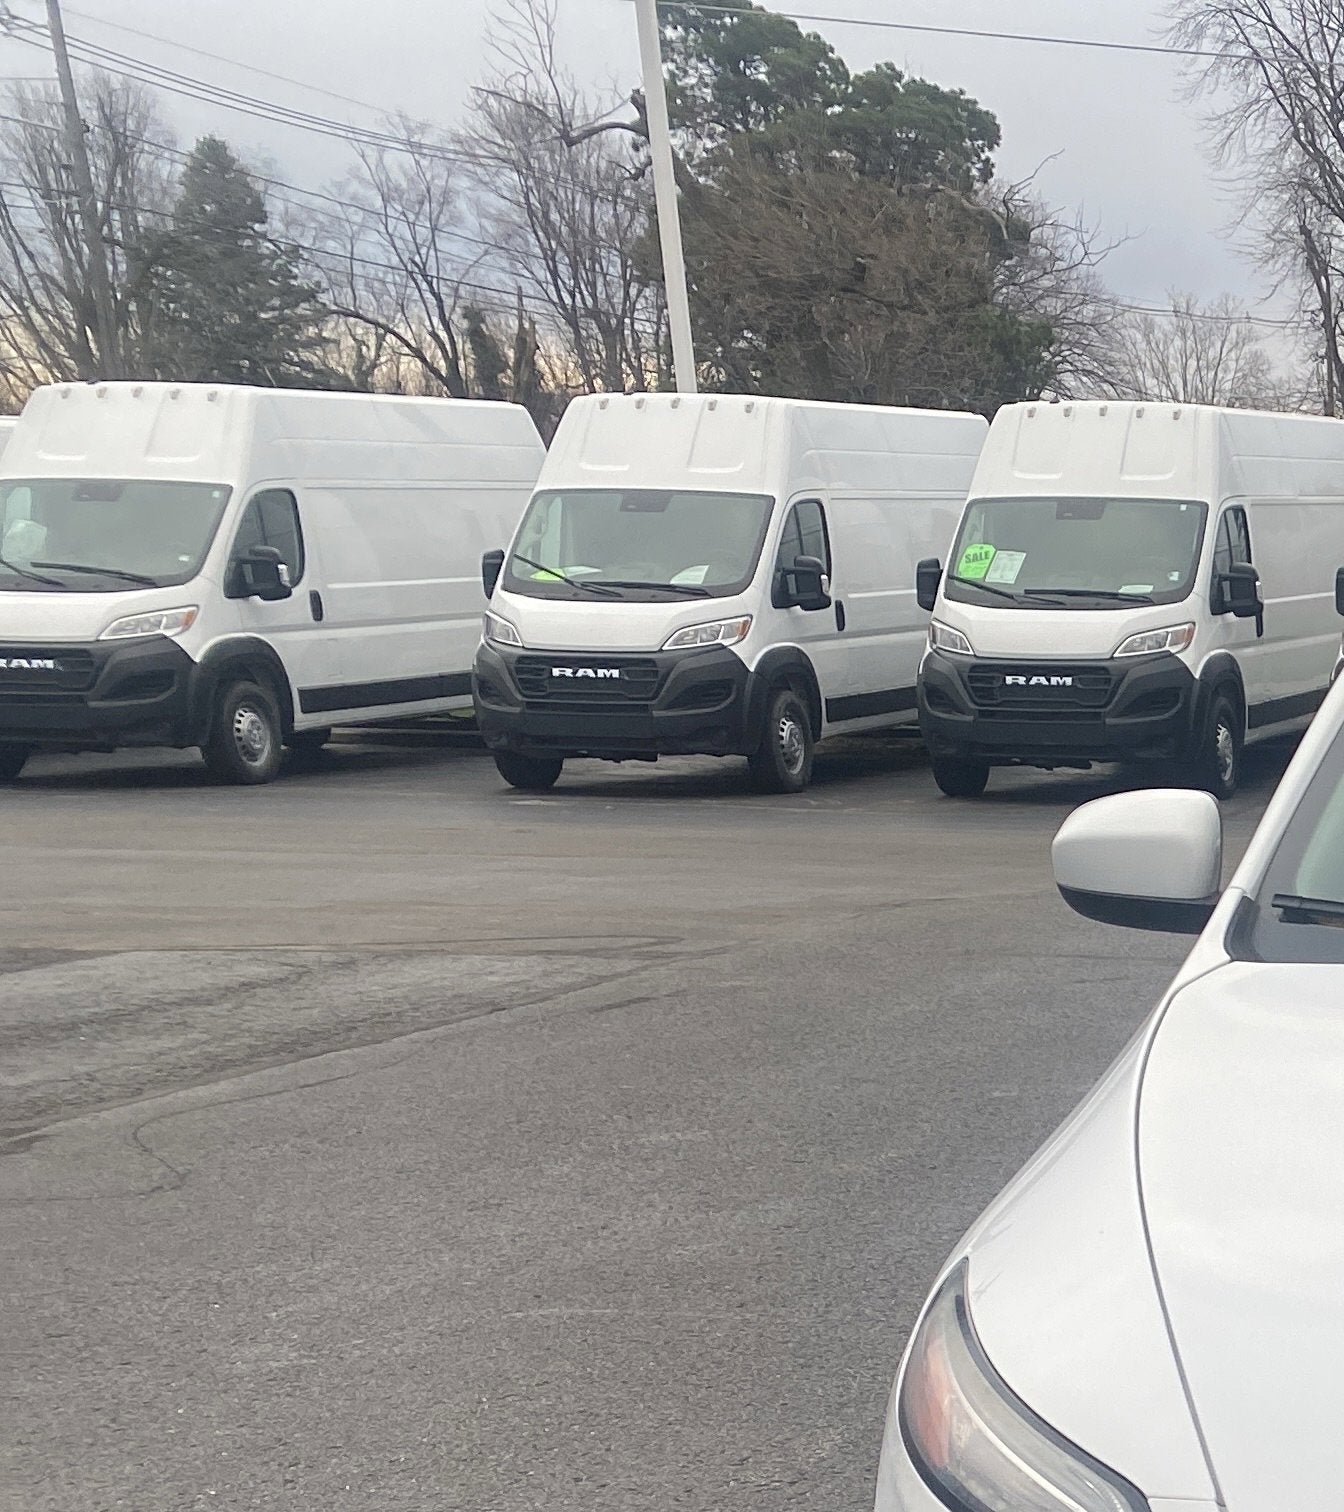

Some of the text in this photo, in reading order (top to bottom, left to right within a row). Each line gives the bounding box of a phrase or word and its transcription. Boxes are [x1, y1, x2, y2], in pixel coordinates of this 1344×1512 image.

[964, 550, 990, 564] SALE
[551, 667, 620, 678] RAM
[1005, 675, 1073, 686] RAM
